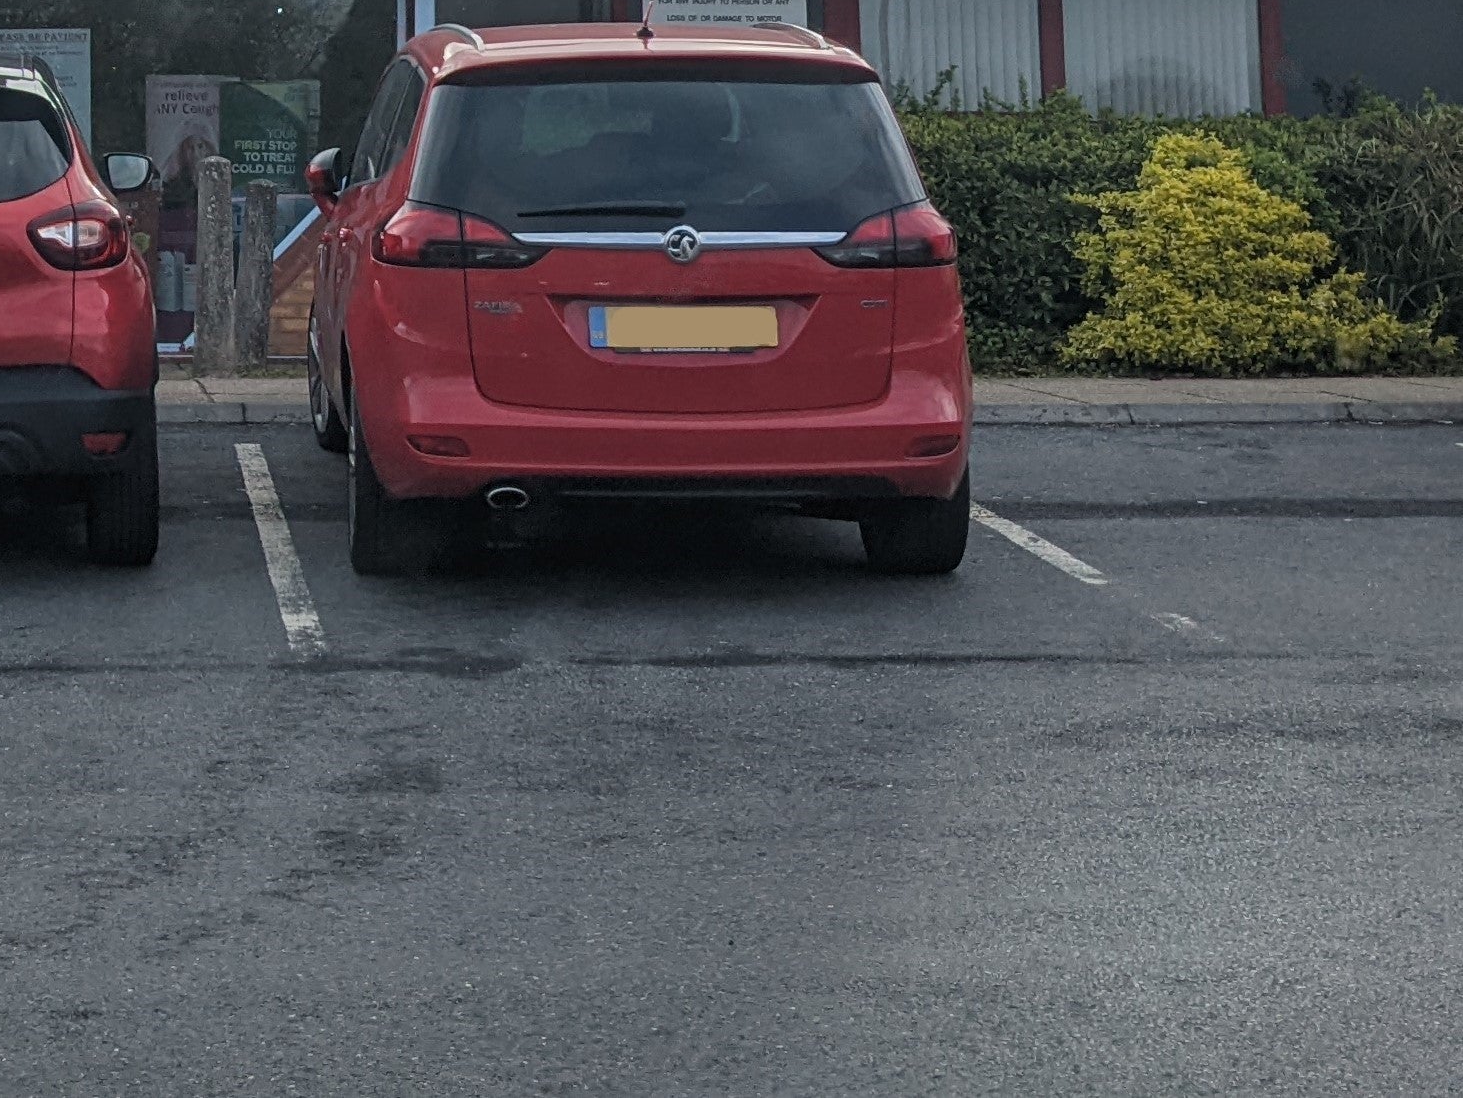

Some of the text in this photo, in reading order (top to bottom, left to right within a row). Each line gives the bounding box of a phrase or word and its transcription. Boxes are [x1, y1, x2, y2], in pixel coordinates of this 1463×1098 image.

[666, 14, 782, 22] LOSS OF OR DAMAGE TO MOTOR
[44, 32, 88, 42] PATIENT
[165, 90, 209, 101] relieve
[265, 128, 297, 139] YOUR
[234, 140, 297, 151] FIRST STOP
[243, 152, 296, 163] TO TREAT
[231, 163, 296, 174] COLD & FLU
